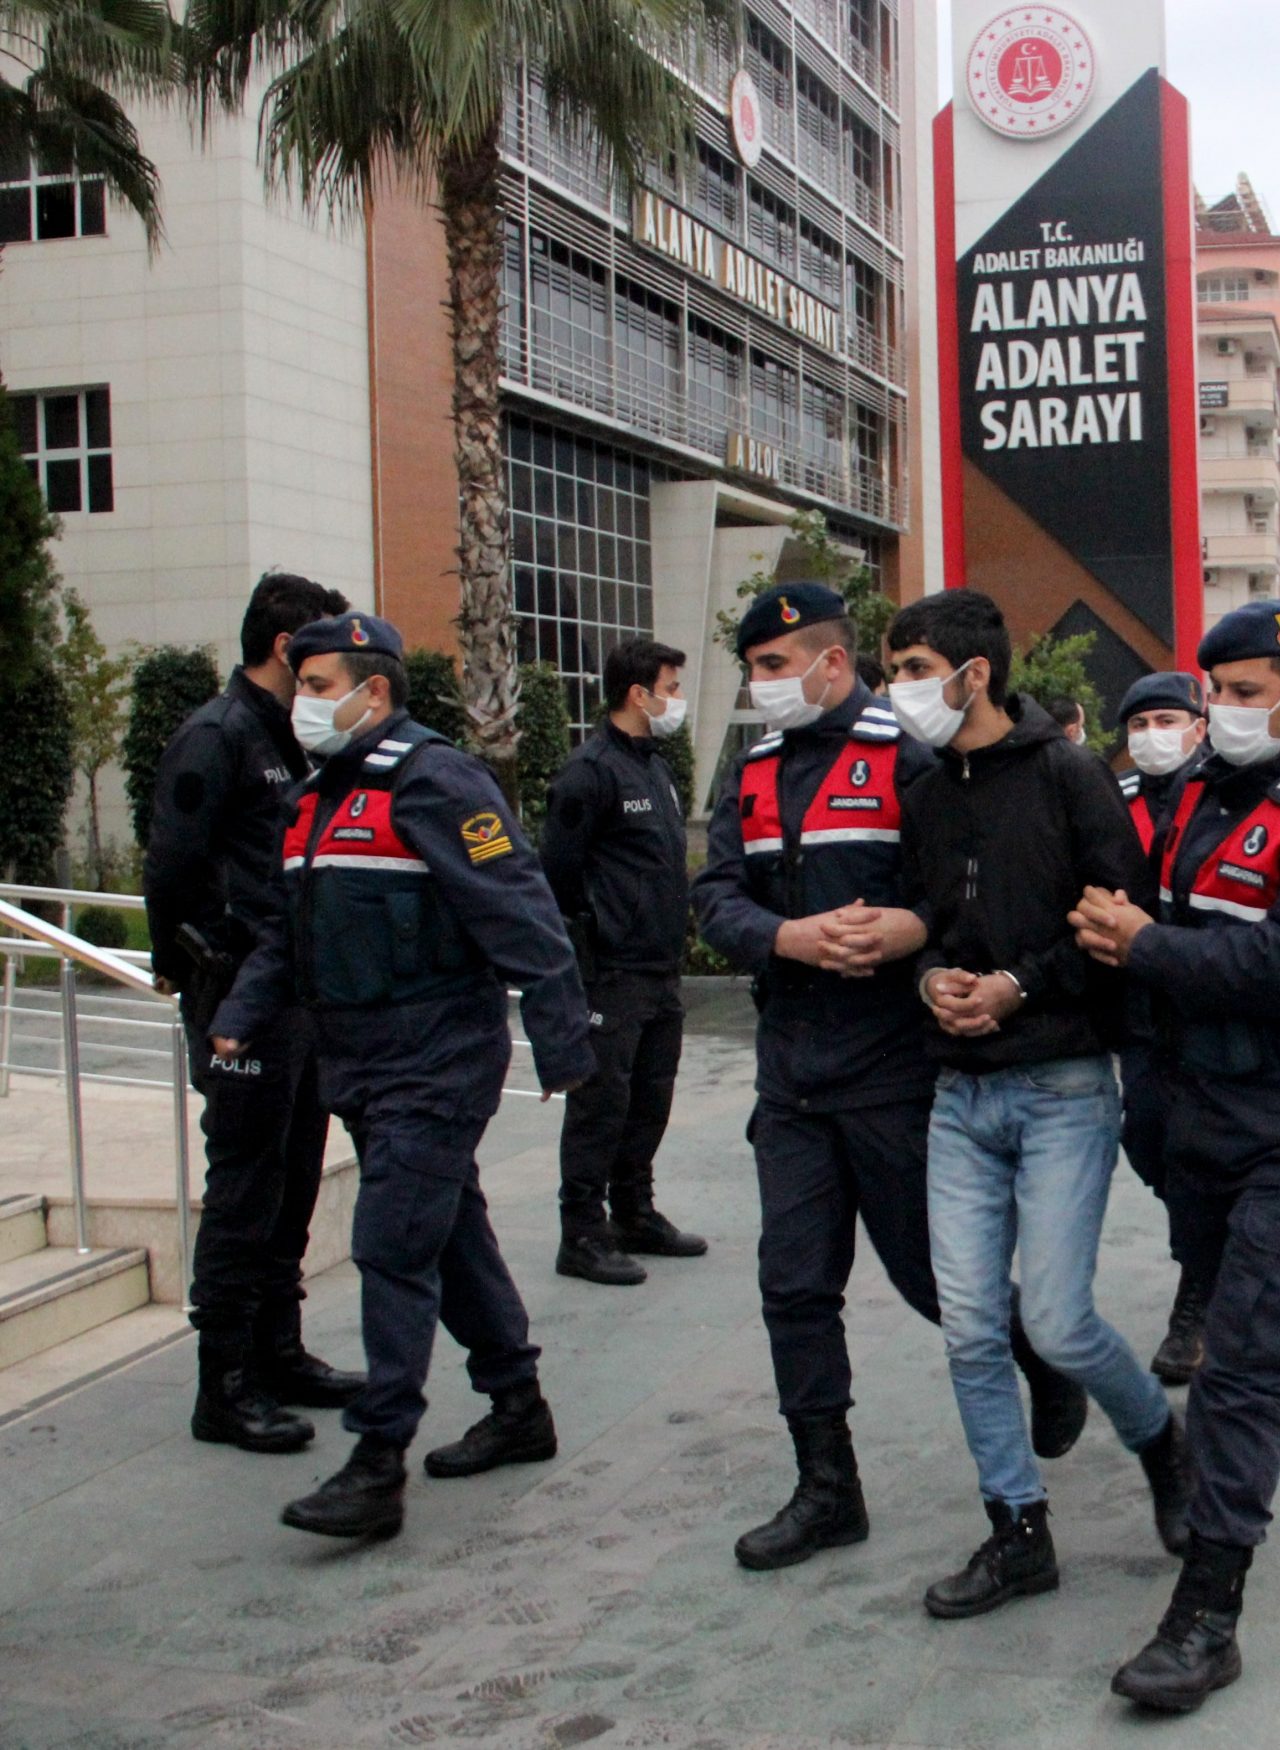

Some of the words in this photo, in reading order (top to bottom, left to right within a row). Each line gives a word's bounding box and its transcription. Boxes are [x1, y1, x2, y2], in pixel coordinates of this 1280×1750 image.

[972, 249, 1041, 275] ADALET
[1044, 237, 1144, 269] BAKANLIĞI
[1040, 221, 1073, 242] T.C.
[644, 191, 715, 281] ALANYA
[725, 243, 784, 322] ADALET
[789, 284, 838, 352] SARAYI
[970, 272, 1148, 332] ALANYA
[975, 331, 1146, 391] ADALET
[979, 391, 1143, 450] SARAYI
[736, 434, 744, 468] A
[748, 438, 780, 480] BLOK
[829, 797, 879, 809] JANDARMA
